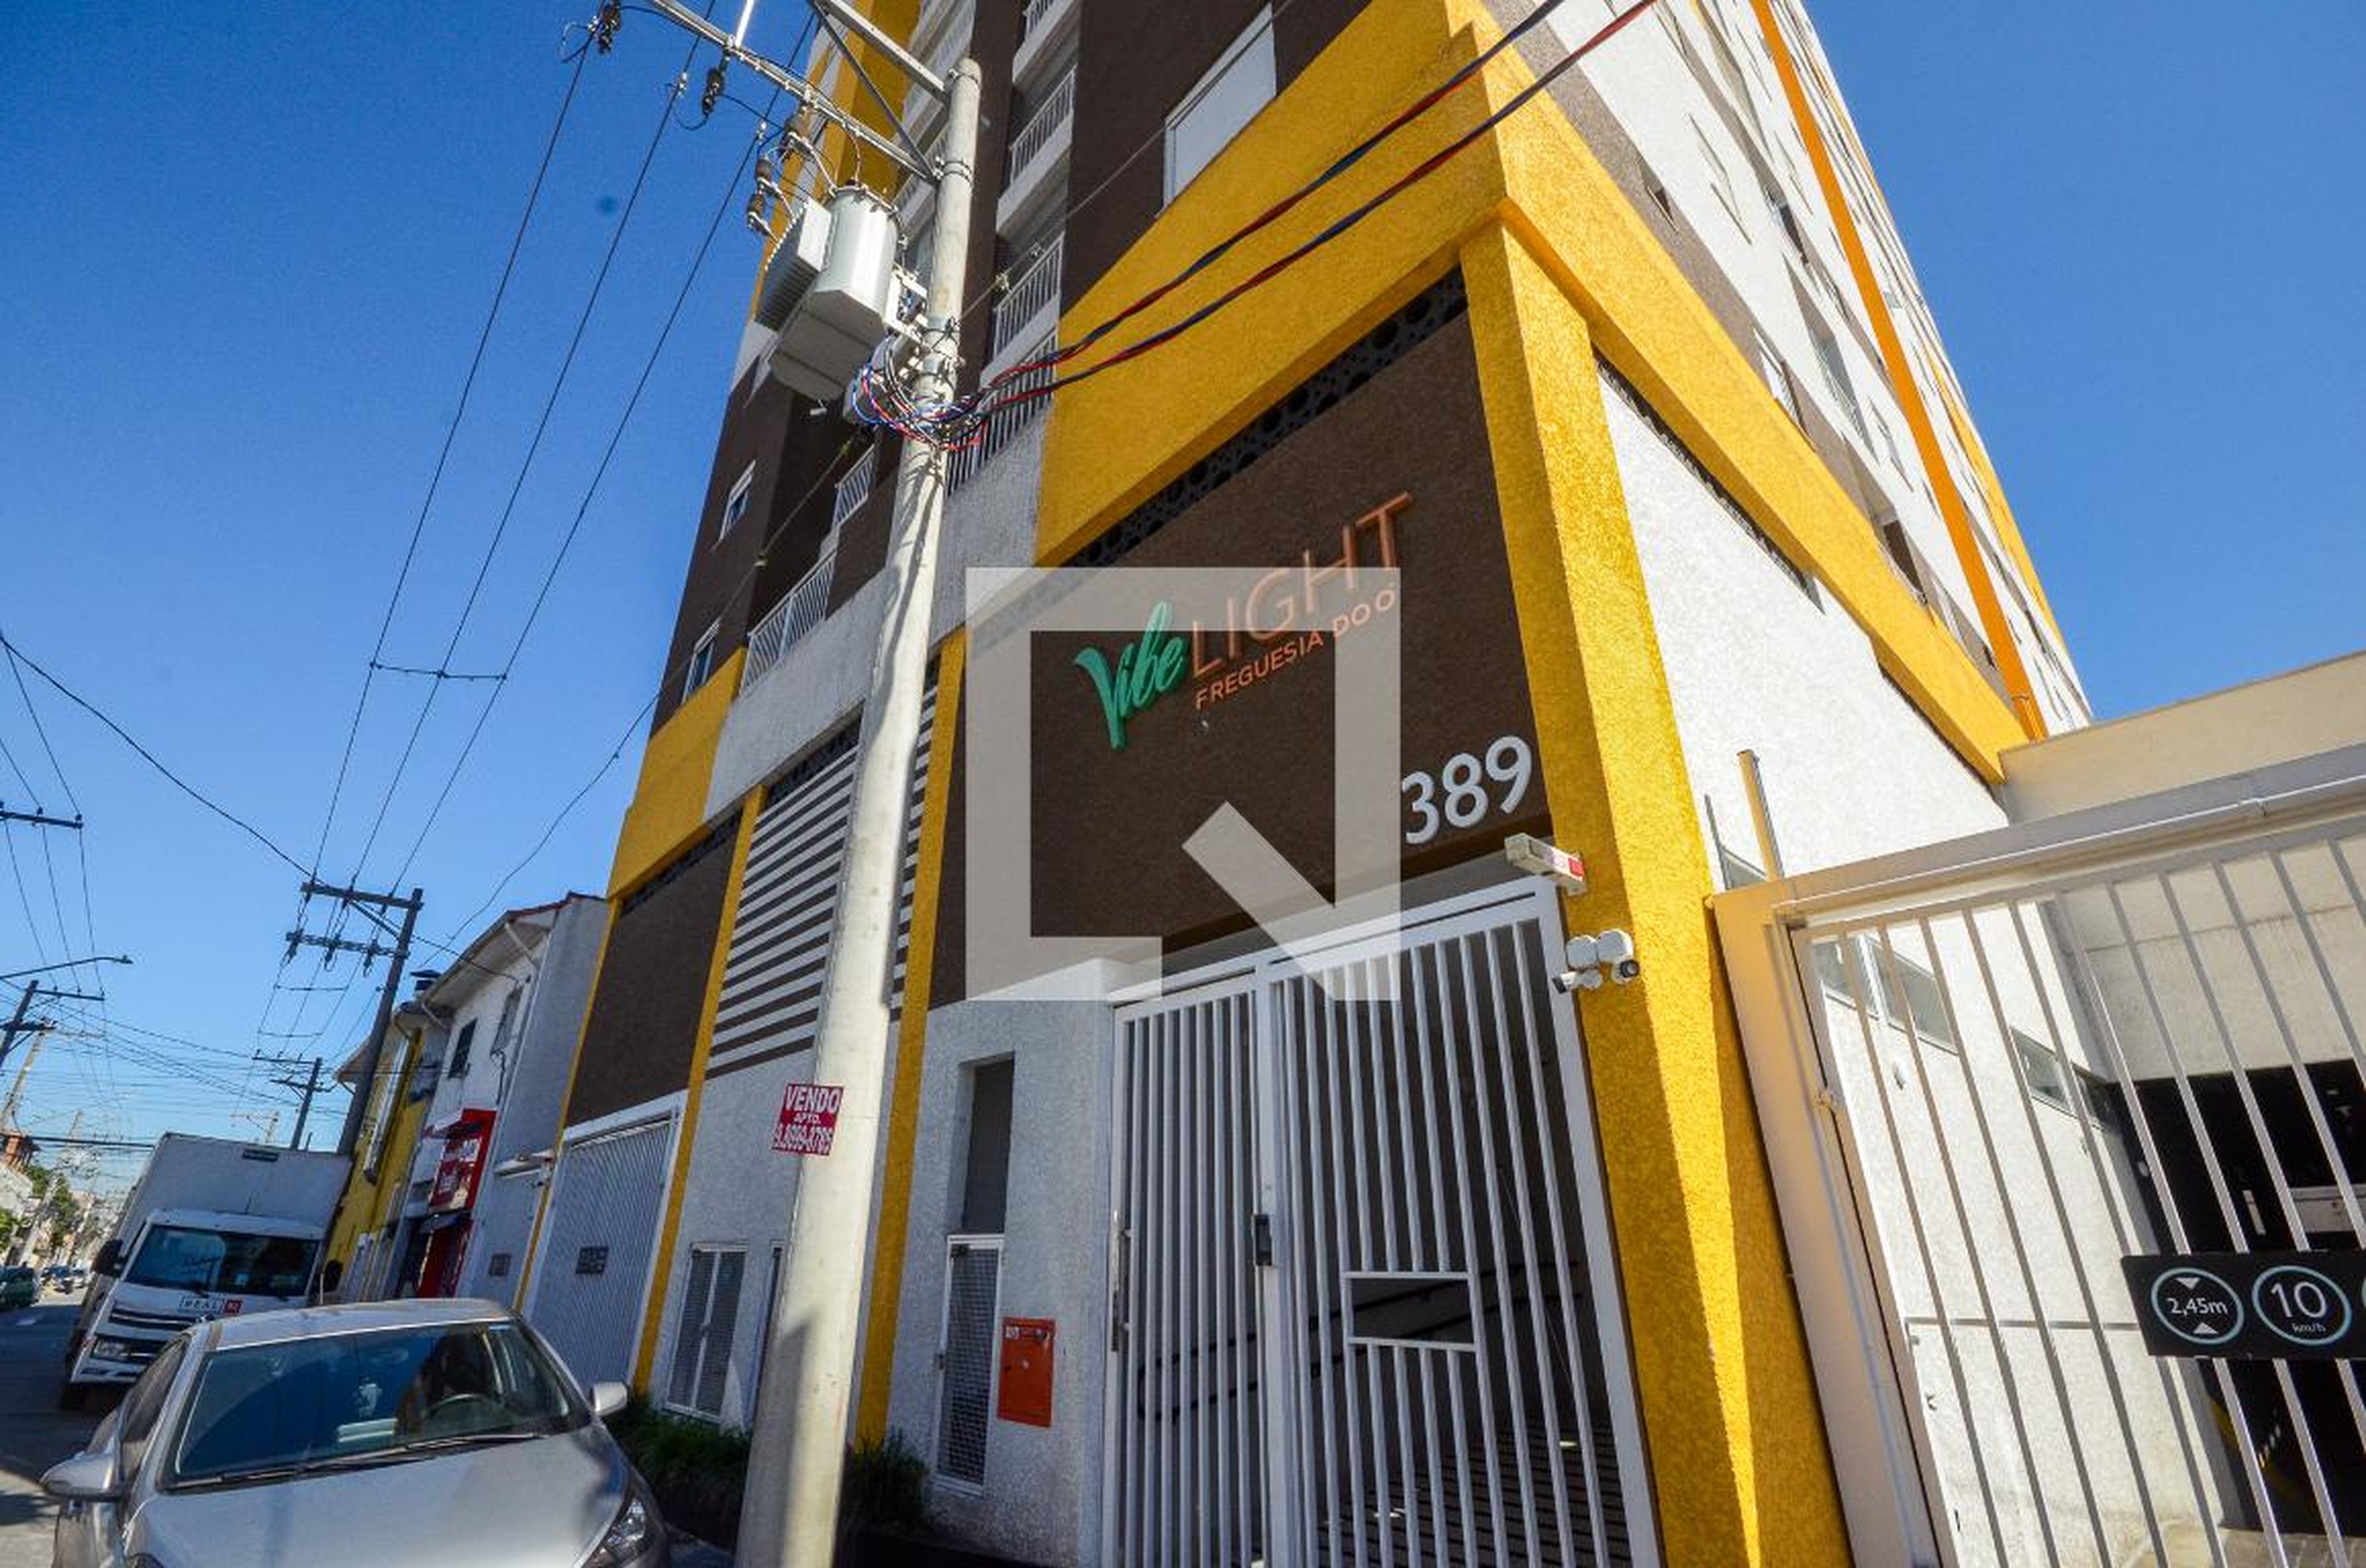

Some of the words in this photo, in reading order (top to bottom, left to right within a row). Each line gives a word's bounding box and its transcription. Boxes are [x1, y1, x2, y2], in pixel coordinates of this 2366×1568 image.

[1075, 601, 1188, 750] Vibe
[1192, 492, 1412, 678] LIGHT
[1195, 627, 1324, 710] FREGUESIA
[1332, 603, 1370, 640] DO
[1402, 735, 1532, 844] 389
[786, 1086, 840, 1113] VENDO
[2166, 1297, 2228, 1316] 2,45m
[2270, 1282, 2327, 1318] 10
[2292, 1322, 2327, 1333] km/h
